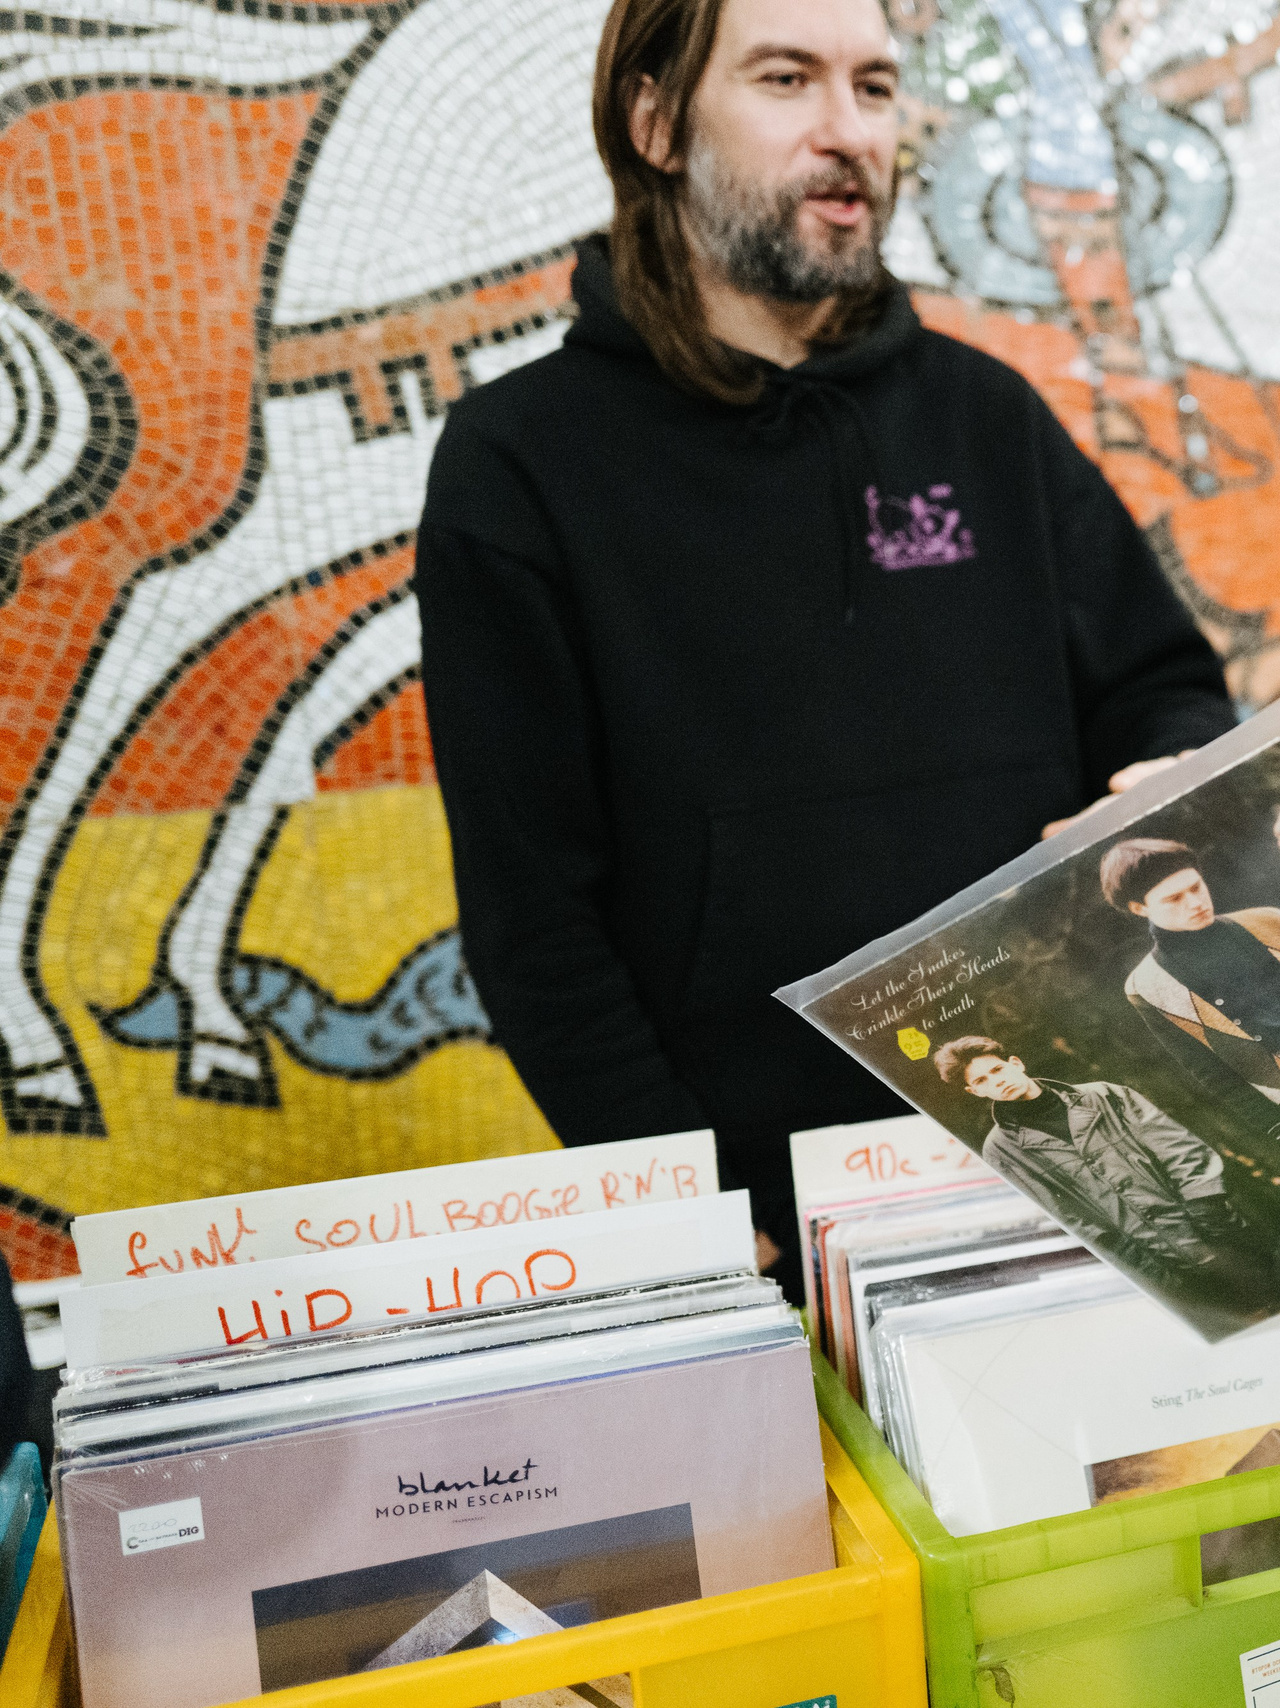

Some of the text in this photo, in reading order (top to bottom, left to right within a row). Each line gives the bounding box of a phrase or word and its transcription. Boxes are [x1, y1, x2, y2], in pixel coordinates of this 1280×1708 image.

[846, 946, 1011, 1041] Crinkle Their Heads
[851, 948, 966, 1011] Let the Snakes
[922, 993, 975, 1031] to death
[1151, 1377, 1263, 1409] Sting The Soul Cages
[397, 1457, 539, 1496] blanket
[375, 1486, 558, 1519] MODERN ESCAPISM
[178, 1526, 199, 1538] DIG
